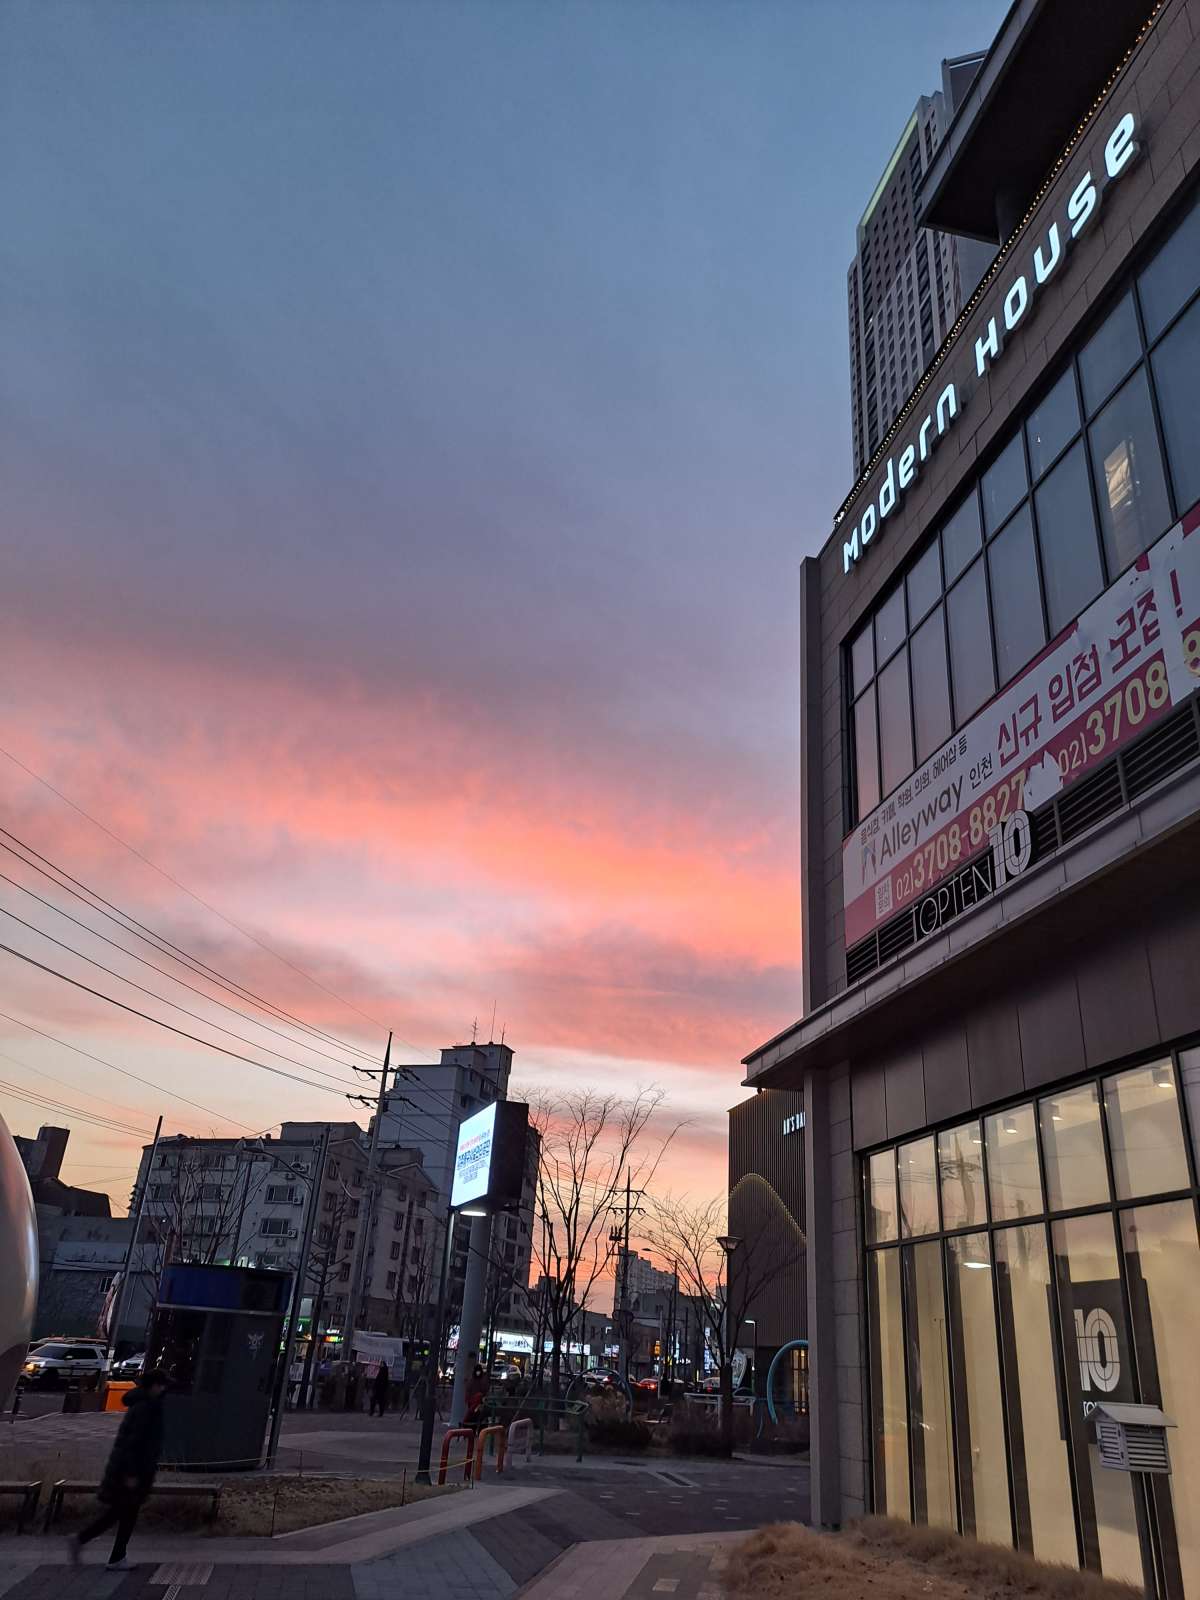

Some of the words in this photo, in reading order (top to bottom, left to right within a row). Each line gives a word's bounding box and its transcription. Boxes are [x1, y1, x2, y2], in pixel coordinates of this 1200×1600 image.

[880, 775, 963, 865] Alleyway
[970, 752, 993, 790] 인천
[998, 692, 1043, 768] 신규
[1048, 643, 1102, 723] 입점
[958, 734, 968, 756] 등
[1073, 1307, 1120, 1393] 10
